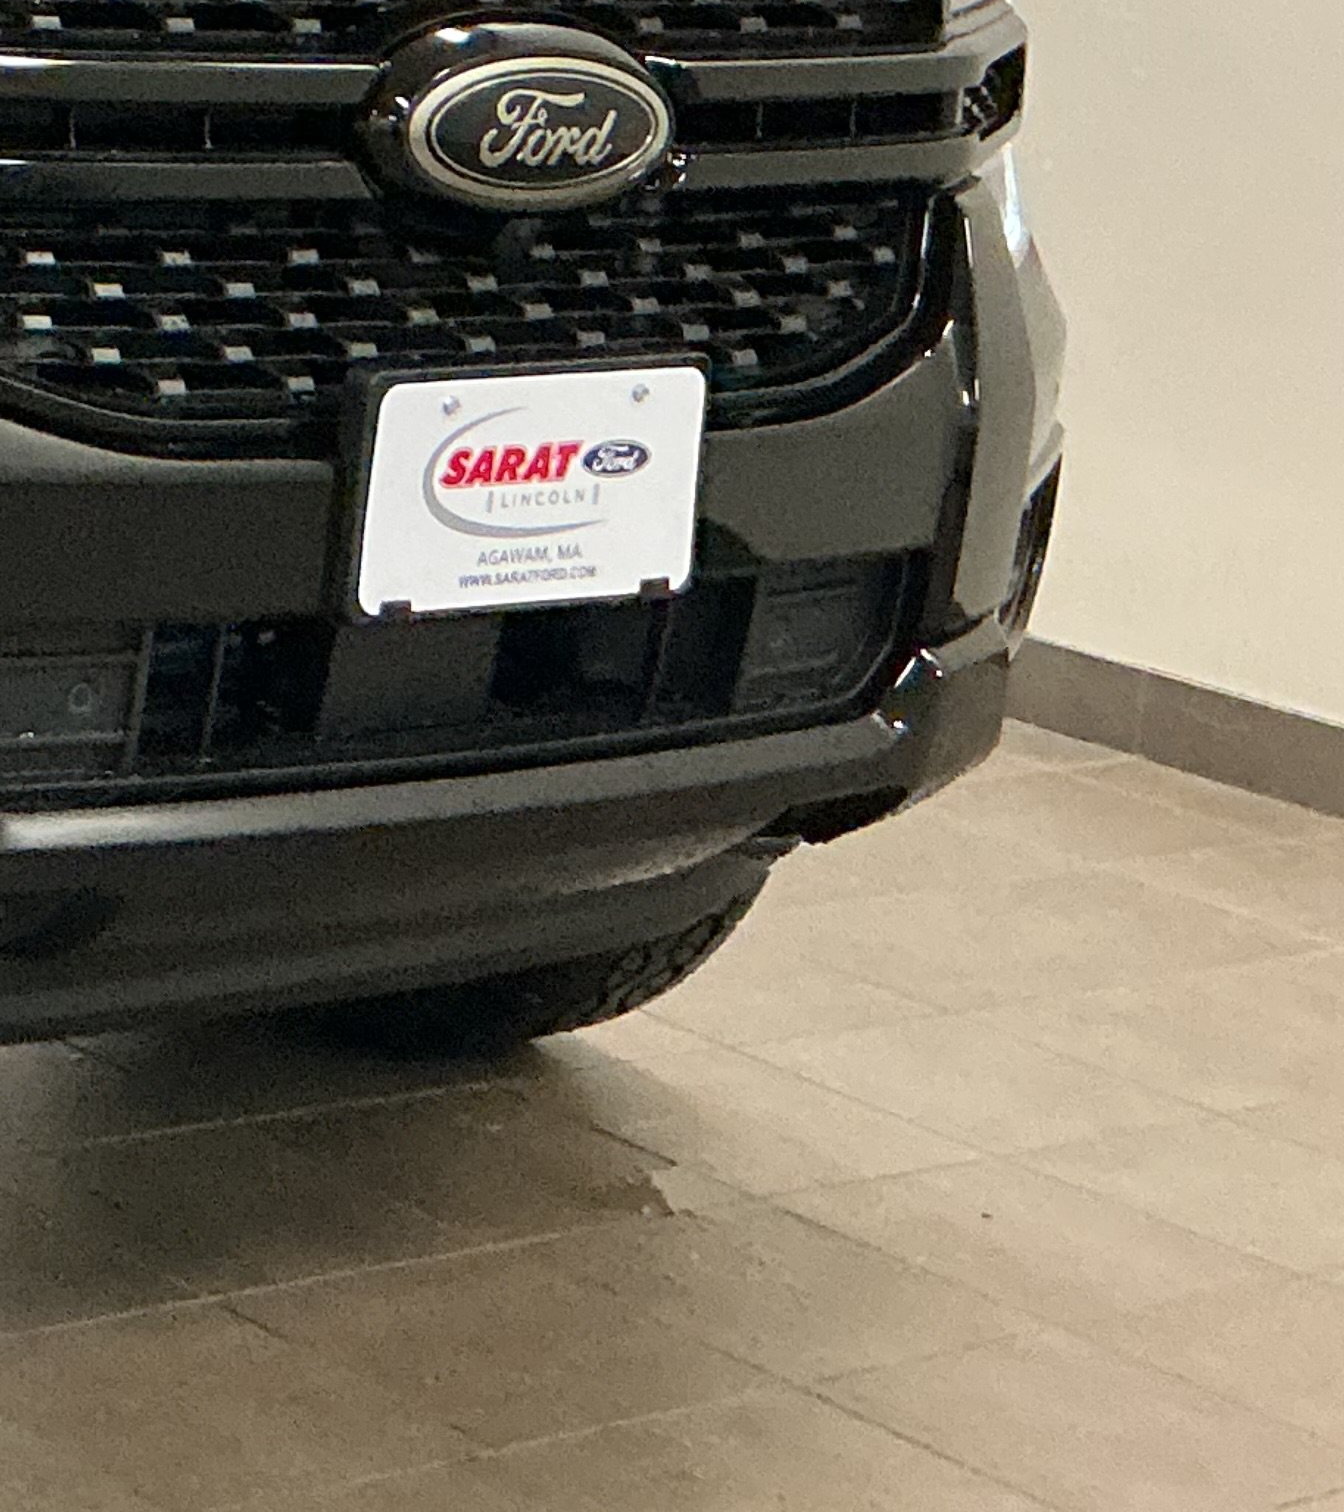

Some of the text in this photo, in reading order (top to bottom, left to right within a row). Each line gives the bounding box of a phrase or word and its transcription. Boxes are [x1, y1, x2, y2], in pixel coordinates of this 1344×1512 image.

[479, 88, 618, 168] Ford
[440, 440, 584, 488] SARAT
[591, 444, 639, 472] Ford
[500, 489, 586, 509] LINCOLN
[477, 542, 583, 566] AGAWAM, MA
